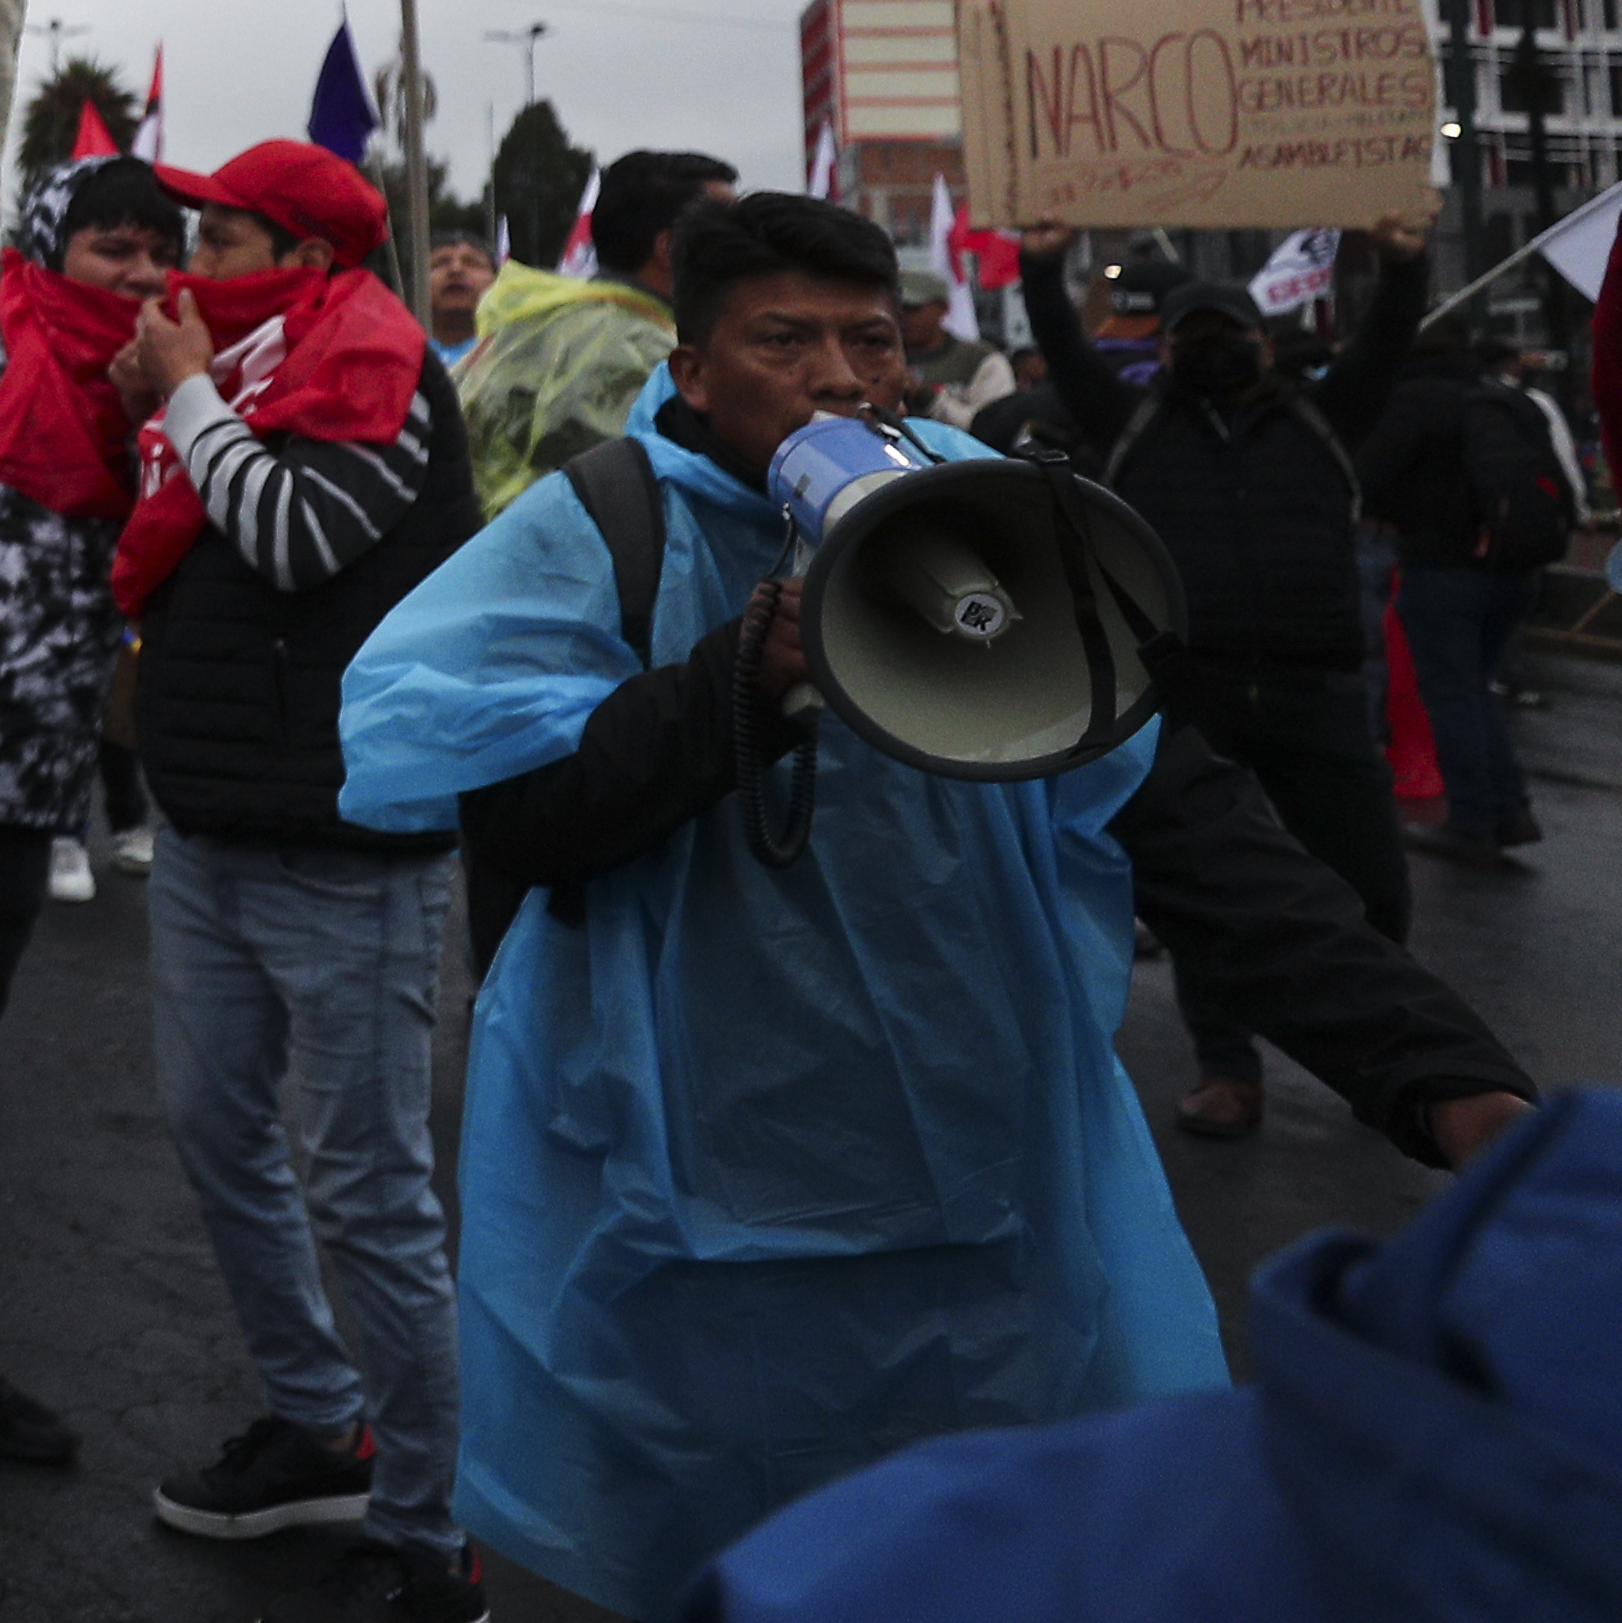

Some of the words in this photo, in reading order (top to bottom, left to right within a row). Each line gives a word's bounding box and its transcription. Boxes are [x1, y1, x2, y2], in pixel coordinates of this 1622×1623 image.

[1239, 26, 1428, 68] MINISTROS
[1026, 29, 1239, 160] NARCO
[1239, 70, 1428, 113] GENERALES
